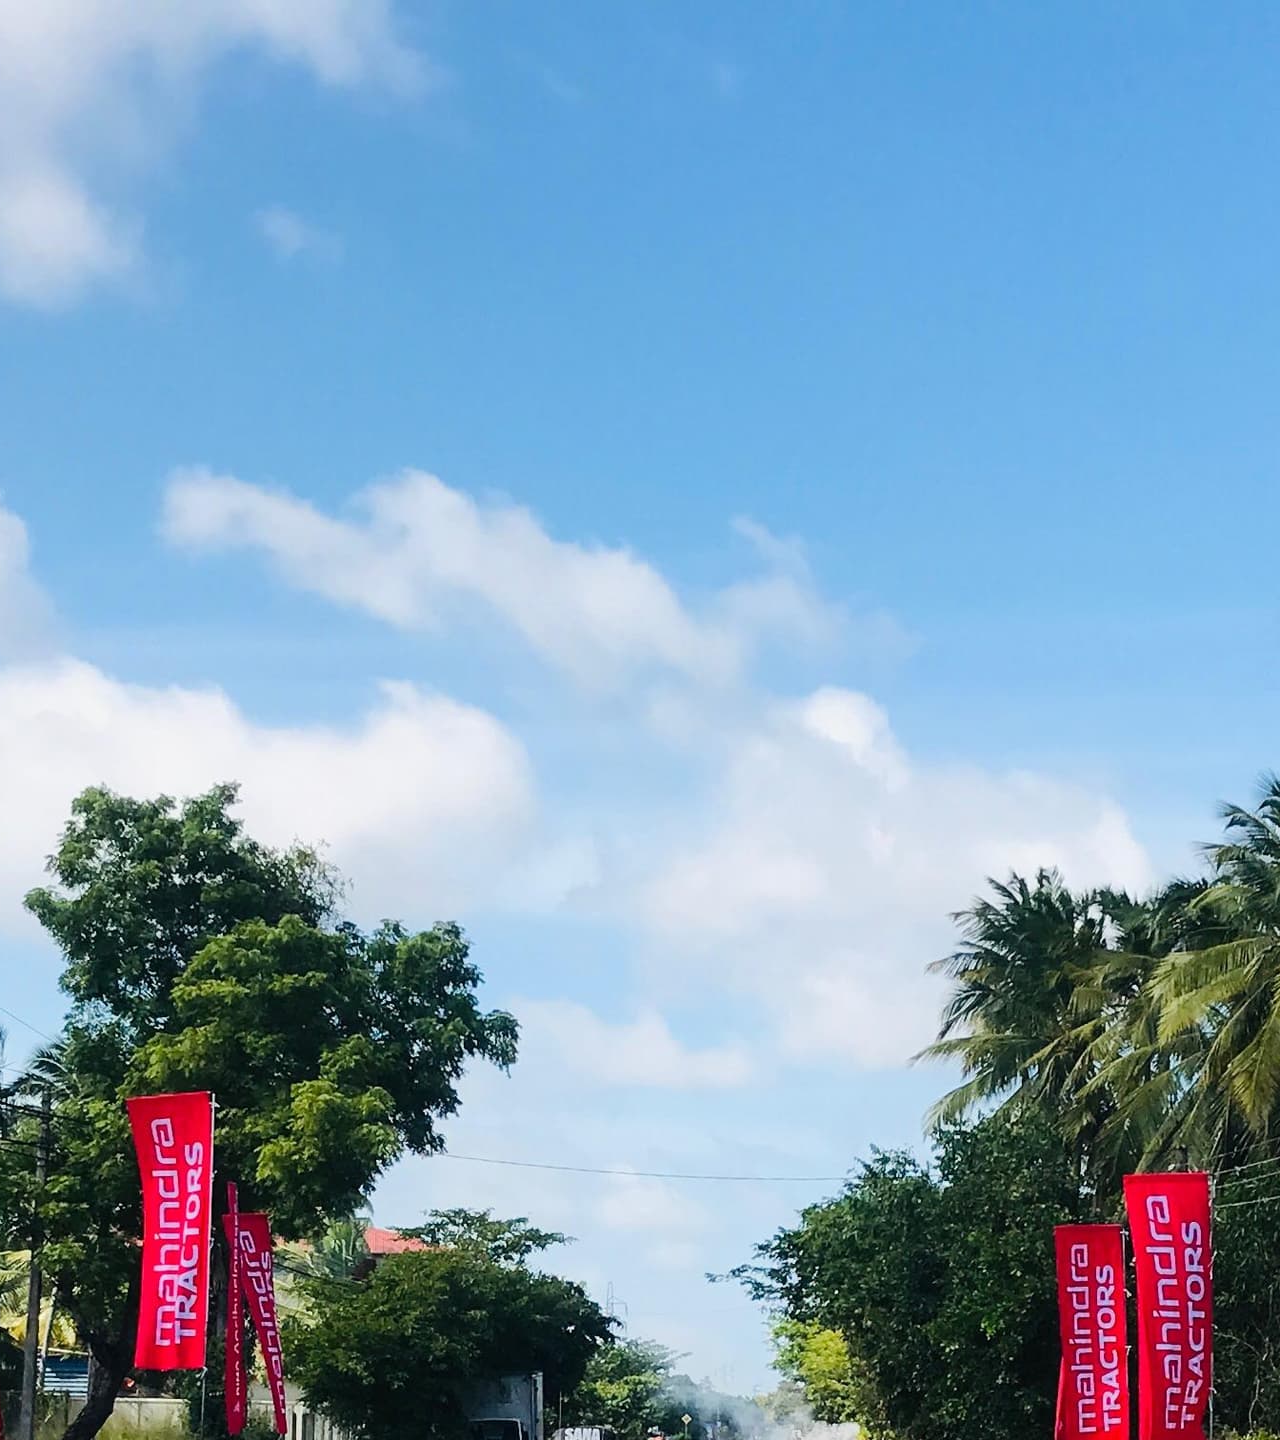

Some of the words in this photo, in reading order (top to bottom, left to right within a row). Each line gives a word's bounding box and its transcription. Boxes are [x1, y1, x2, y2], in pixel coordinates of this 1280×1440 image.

[151, 1117, 180, 1346] mahindra
[174, 1141, 204, 1345] TRACTORS
[1146, 1195, 1182, 1430] mahindra
[1181, 1221, 1206, 1430] TRACTORS
[1066, 1243, 1097, 1433] mahindra
[1095, 1264, 1122, 1432] TRACTORS
